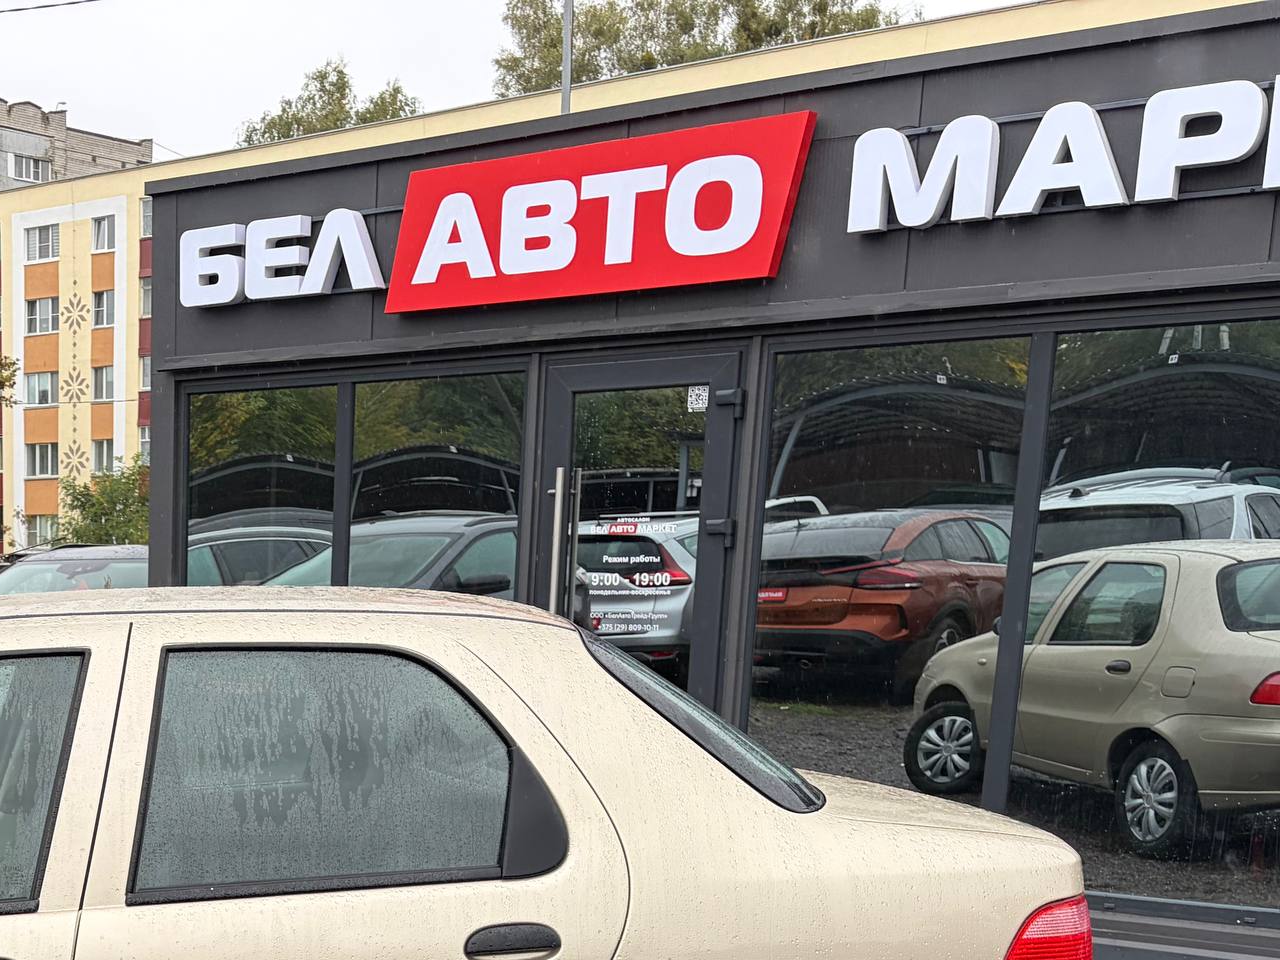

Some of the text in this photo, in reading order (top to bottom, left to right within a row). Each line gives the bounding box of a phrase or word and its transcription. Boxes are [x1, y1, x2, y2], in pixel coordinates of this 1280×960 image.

[179, 74, 1280, 308] БЕЛ АВТО МАР
[610, 525, 635, 533] АВТО
[637, 523, 678, 533] МАРКЕТ
[602, 554, 661, 564] Режим работы
[591, 573, 620, 586] 9:00
[632, 572, 671, 586] 19:00
[614, 624, 627, 632] (29)
